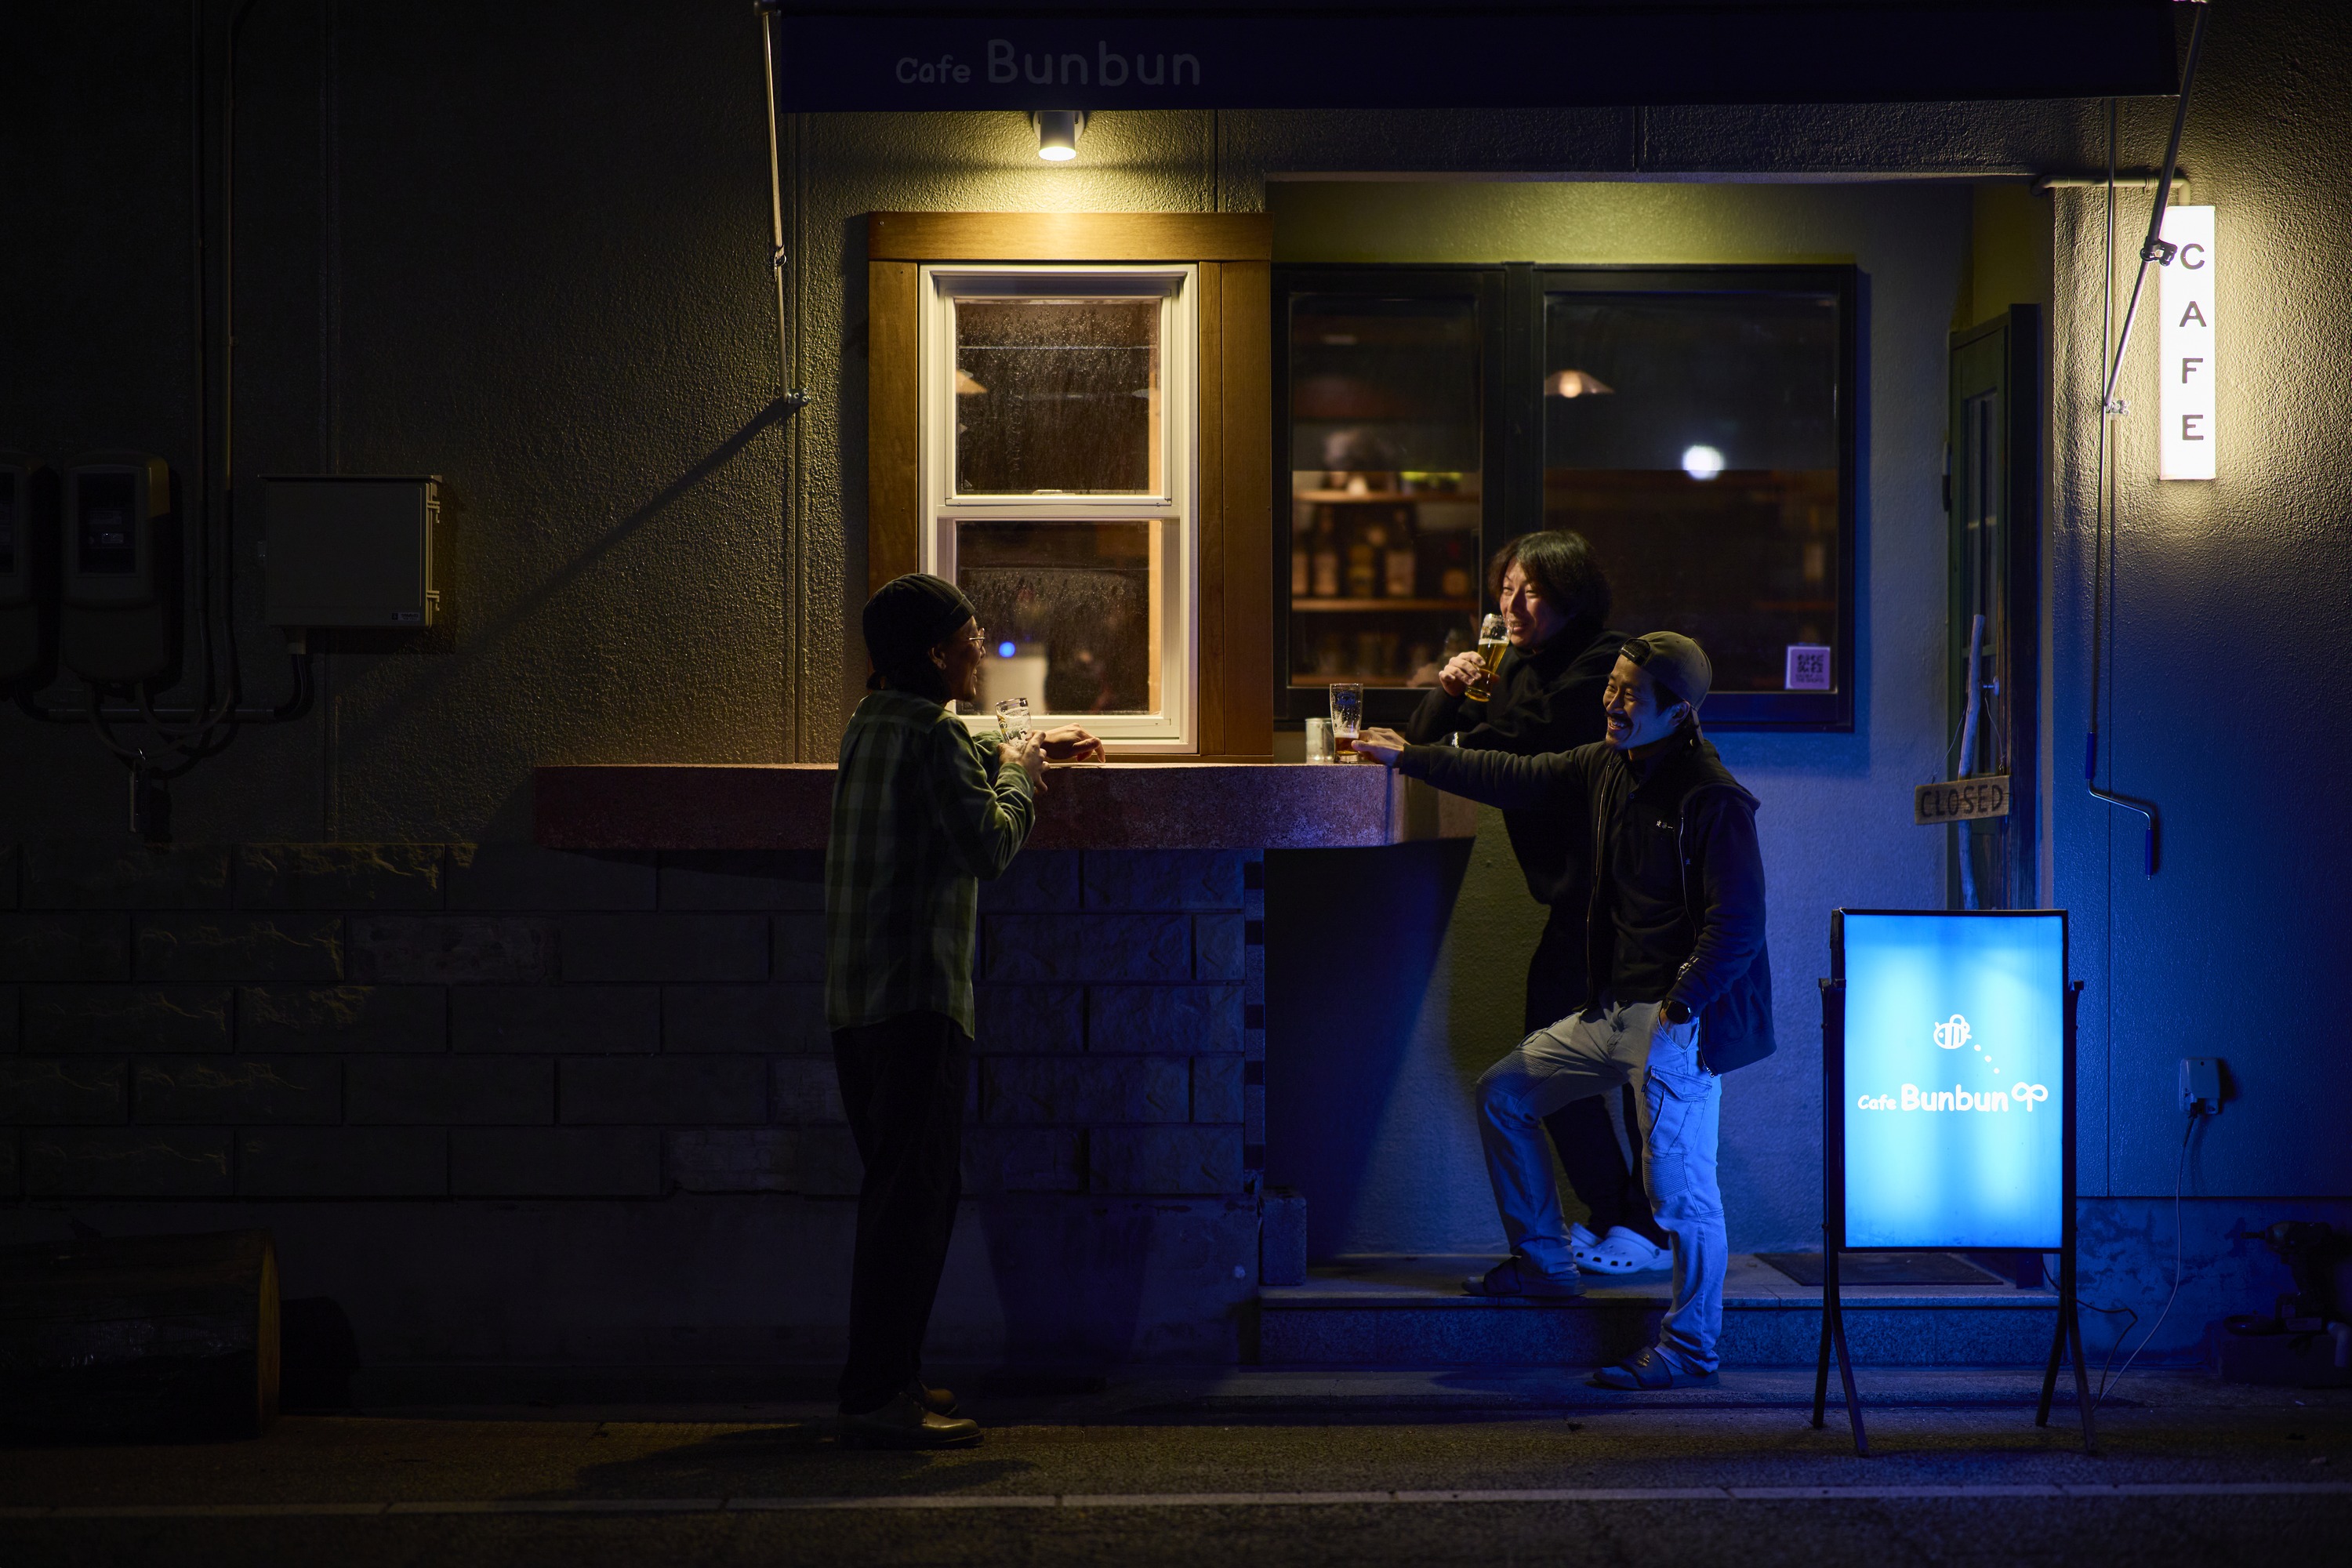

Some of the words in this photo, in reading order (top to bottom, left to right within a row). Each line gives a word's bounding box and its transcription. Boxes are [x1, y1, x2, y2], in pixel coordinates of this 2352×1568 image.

[895, 55, 971, 84] Cafe
[987, 39, 1201, 87] Bunbun
[2179, 243, 2207, 441] CAFE
[1921, 785, 2003, 817] CLOSED
[1857, 1094, 1896, 1110] Cafe
[1901, 1083, 2009, 1112] Bunbun
